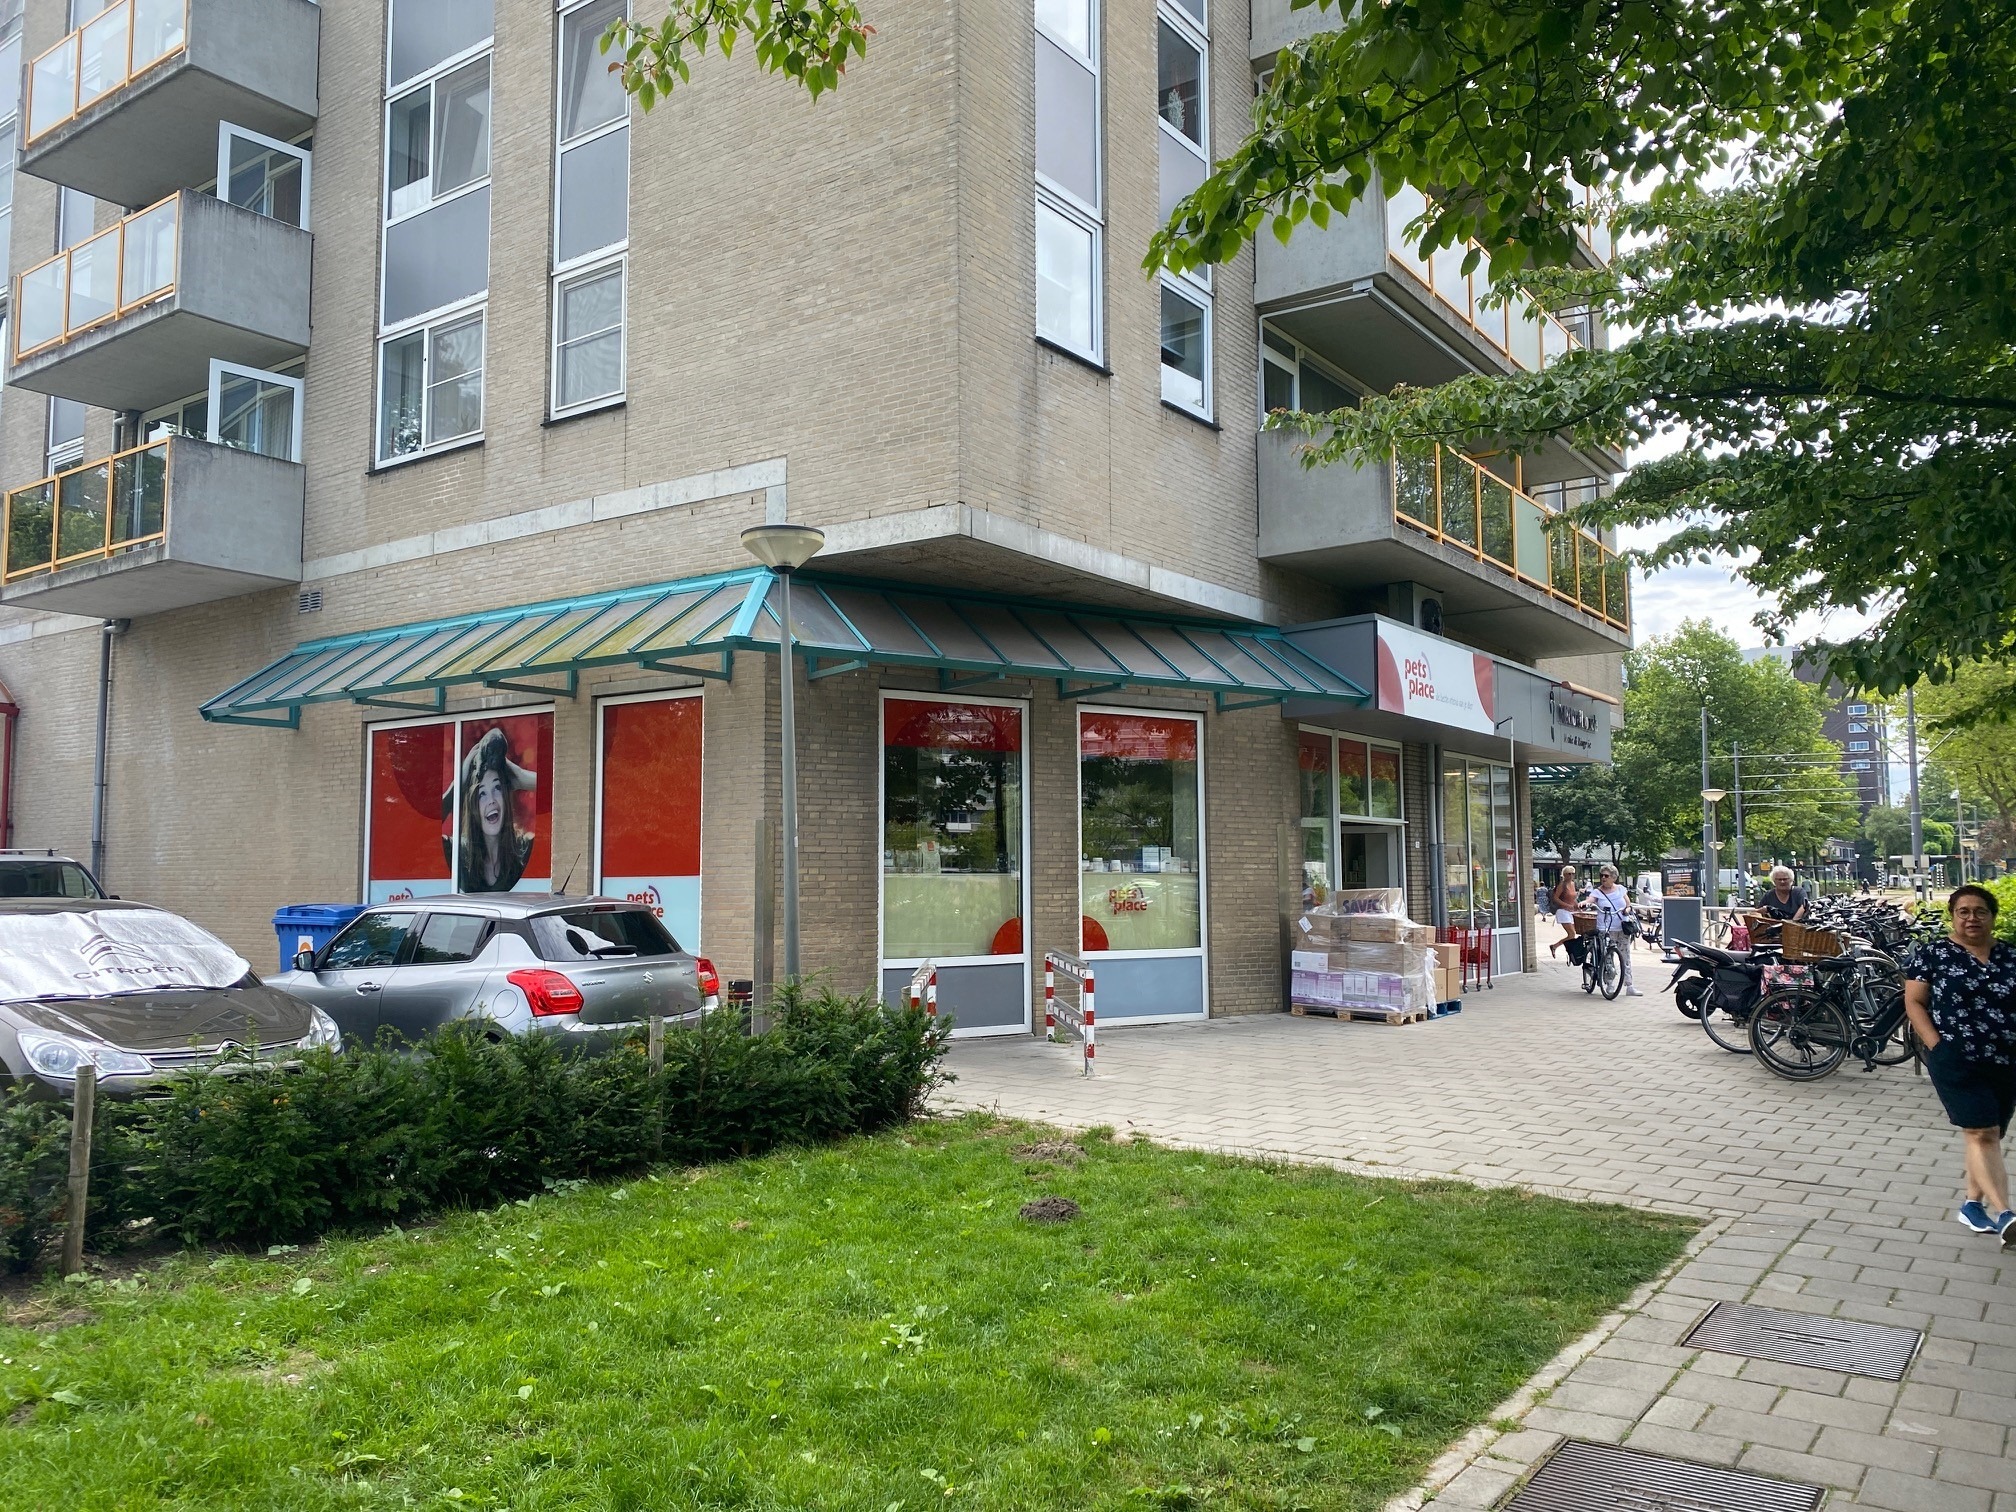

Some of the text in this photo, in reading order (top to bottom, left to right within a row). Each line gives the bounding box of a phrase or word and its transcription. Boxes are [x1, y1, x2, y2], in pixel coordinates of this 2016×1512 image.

[1404, 658, 1427, 680] pets
[1409, 678, 1435, 700] place
[1108, 889, 1138, 903] pets
[1113, 900, 1148, 915] place
